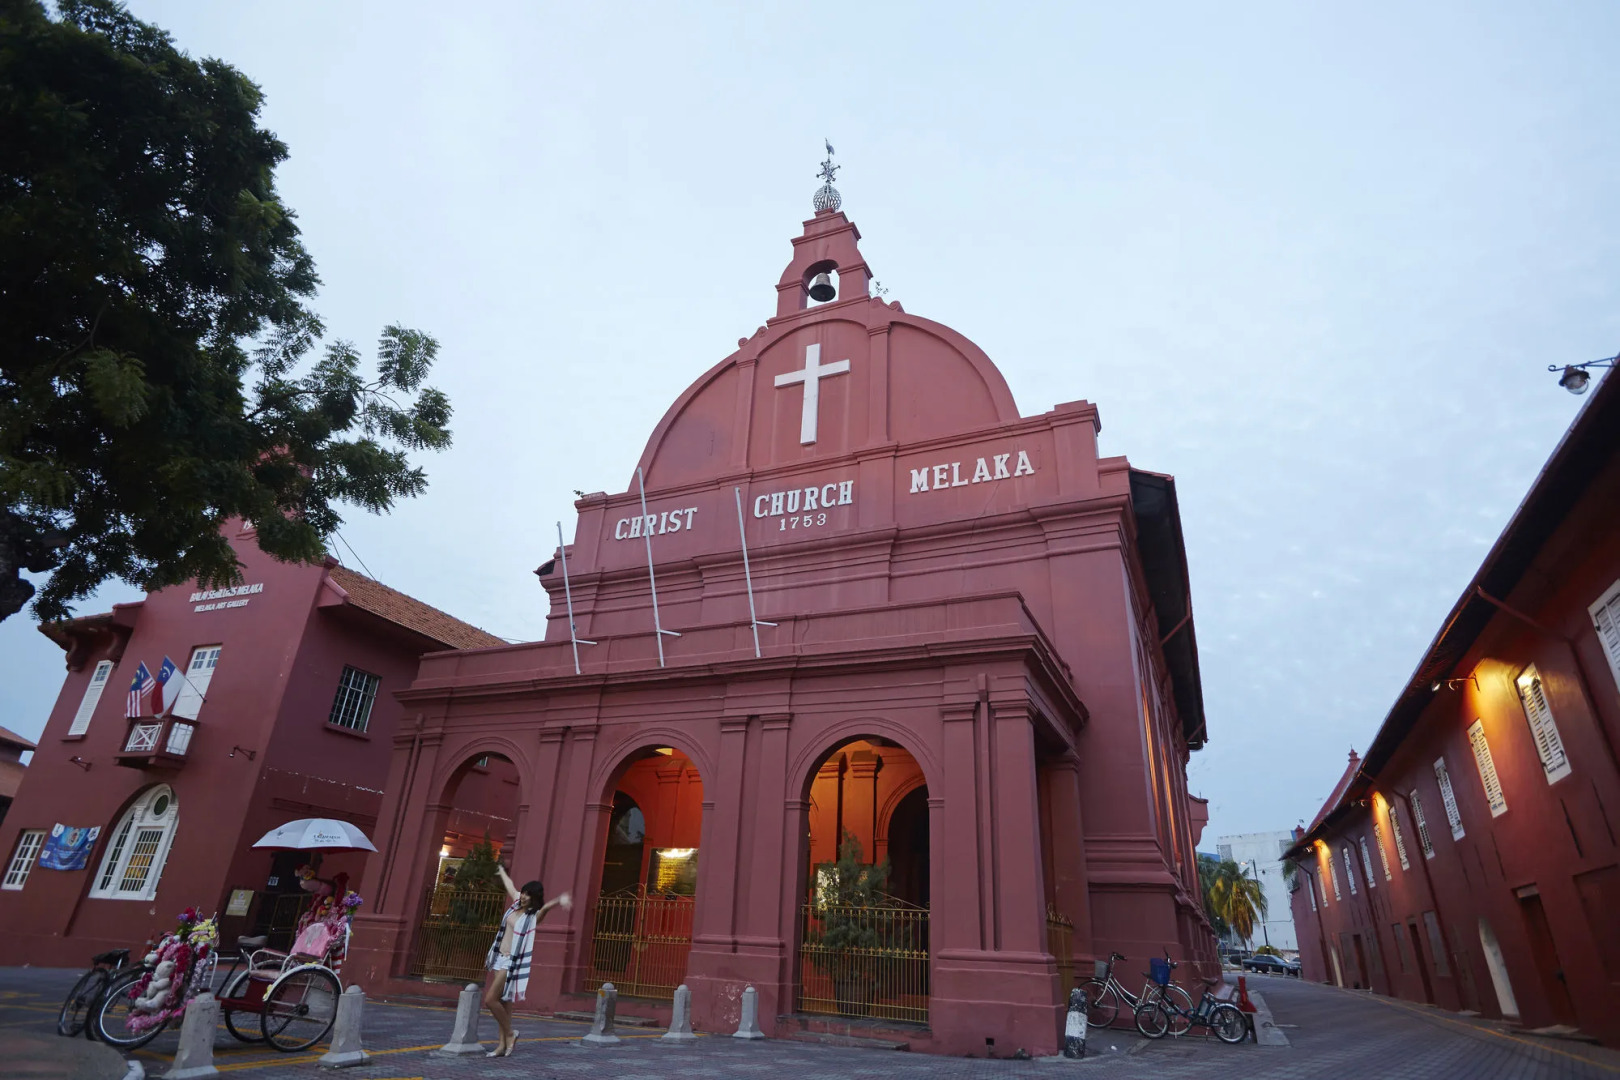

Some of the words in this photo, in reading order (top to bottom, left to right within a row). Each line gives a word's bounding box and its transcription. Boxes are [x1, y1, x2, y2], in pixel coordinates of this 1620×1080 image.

[615, 507, 698, 540] CHRIST
[754, 480, 853, 518] CHURCH
[909, 450, 1035, 494] MELAKA
[780, 513, 826, 531] 1753
[189, 592, 208, 602] BALAI
[236, 583, 263, 595] MELAKA
[194, 604, 215, 612] MELAKA
[226, 599, 249, 608] GALLERY
